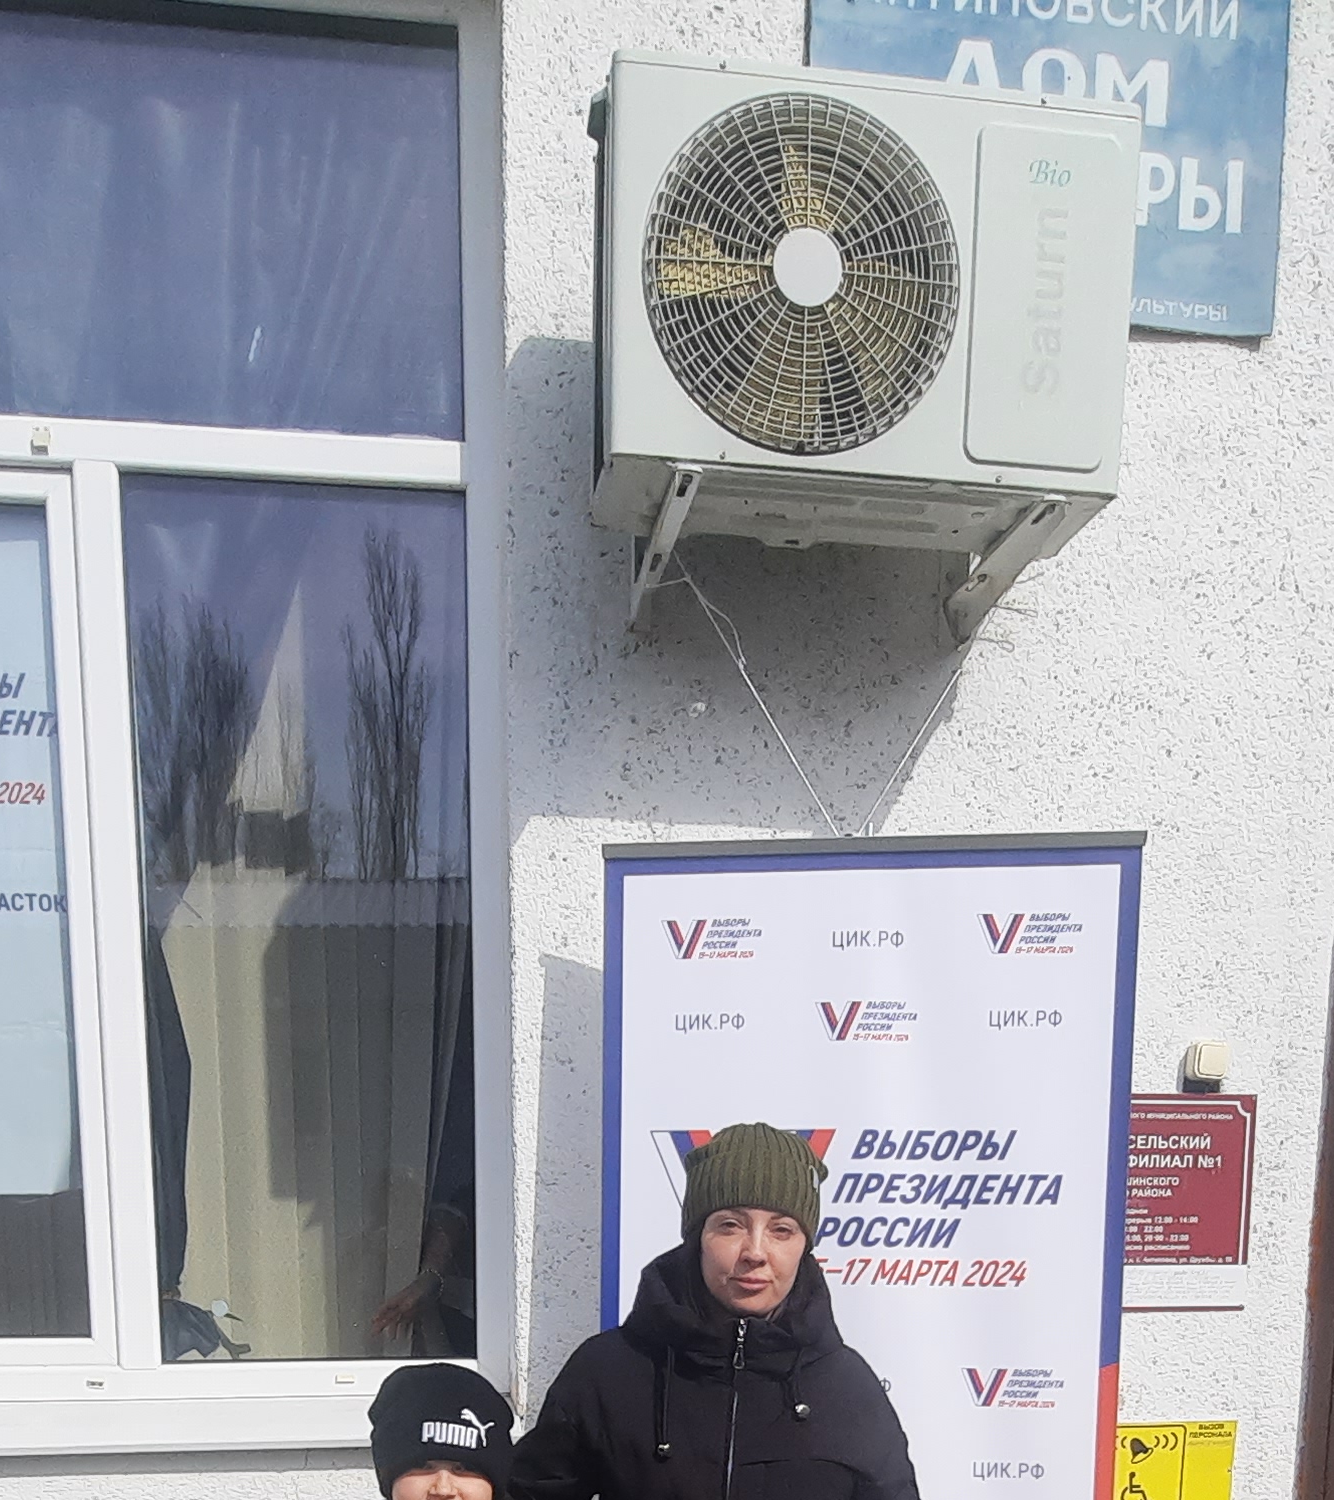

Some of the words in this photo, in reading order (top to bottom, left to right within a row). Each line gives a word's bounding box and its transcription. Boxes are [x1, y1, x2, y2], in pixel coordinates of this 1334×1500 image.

[1029, 159, 1072, 187] Bio
[1020, 207, 1069, 396] Saturn
[710, 918, 751, 928] ВЫБОРЫ
[1028, 912, 1072, 922] ВЫБОРЫ
[1023, 923, 1084, 933] ПРЕЗИДЕНТА
[701, 940, 738, 950] РОССИИ
[831, 930, 905, 951] ЦИК.РФ
[1018, 935, 1058, 944] РОССИИ
[865, 1000, 907, 1010] ВЫБОРЫ
[674, 1013, 745, 1035] ЦИК.РФ
[855, 1022, 893, 1032] РОССИИ
[988, 1009, 1063, 1031] ЦИК.РФ
[851, 1128, 1018, 1161] ВЫБОРЫ
[831, 1172, 1063, 1210] ПРЕЗИДЕНТА
[1131, 1187, 1173, 1198] РАЙОНА
[814, 1216, 961, 1248] РОССИИ
[871, 1259, 959, 1287] МАРТА
[962, 1260, 1028, 1288] 2024
[1011, 1368, 1053, 1378] ВЫБОРЫ
[1006, 1379, 1065, 1389] ПРЕЗИДЕНТА
[1002, 1389, 1039, 1399] РОССИИ
[421, 1421, 479, 1449] PUMA
[972, 1461, 1045, 1481] ЦИК.РФ
